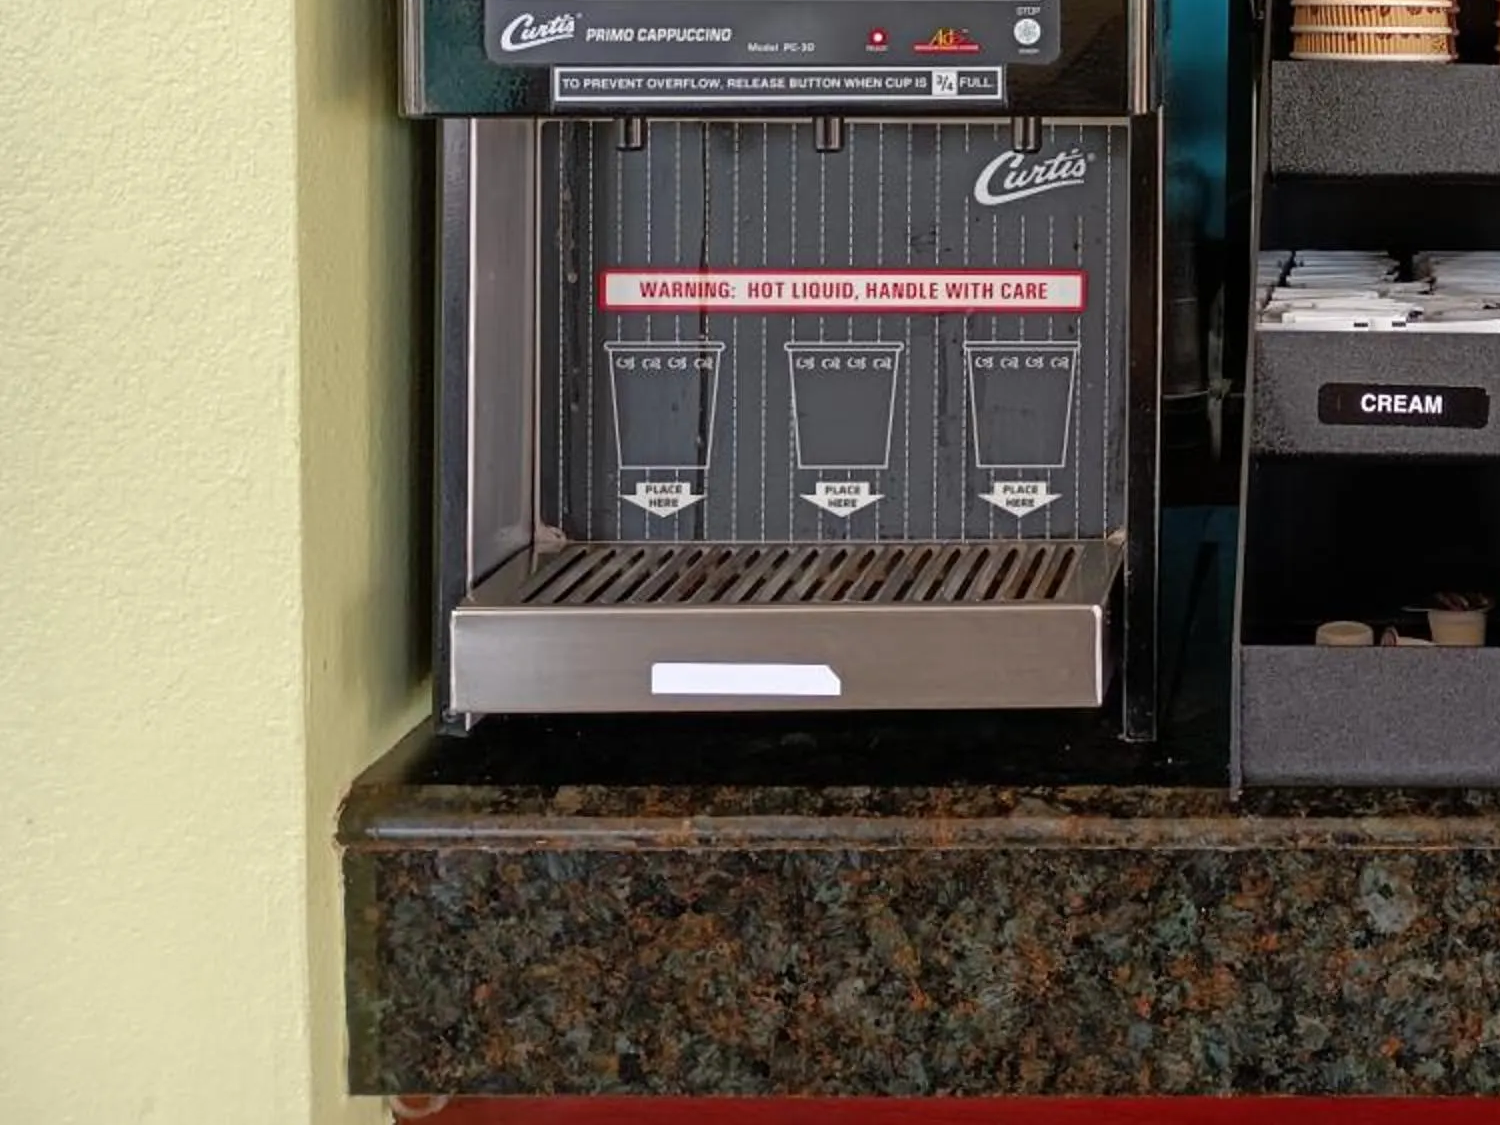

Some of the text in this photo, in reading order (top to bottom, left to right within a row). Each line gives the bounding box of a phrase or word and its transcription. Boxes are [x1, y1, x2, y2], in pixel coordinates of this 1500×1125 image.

[501, 12, 576, 51] Curtis
[586, 27, 734, 43] PRIMO CAPPUCCINO
[562, 78, 581, 89] TO
[583, 78, 642, 89] PREVENT
[647, 78, 724, 91] OVERFLOW,
[727, 77, 785, 89] RELEASE
[789, 77, 841, 88] BUTTON
[843, 77, 882, 88] WHEN
[884, 77, 912, 88] CUP
[916, 77, 927, 88] IS
[974, 148, 1087, 205] Curtis
[639, 281, 1048, 301] WARNING: HOT LIQUID, HANDLE WITH CARE
[1360, 393, 1443, 414] CREAM
[645, 484, 683, 496] PLACE
[825, 484, 861, 496] PLACE
[1002, 484, 1039, 496] PLACE
[648, 497, 679, 508] HERE
[828, 497, 858, 508] HERE
[1006, 497, 1036, 508] HERE
